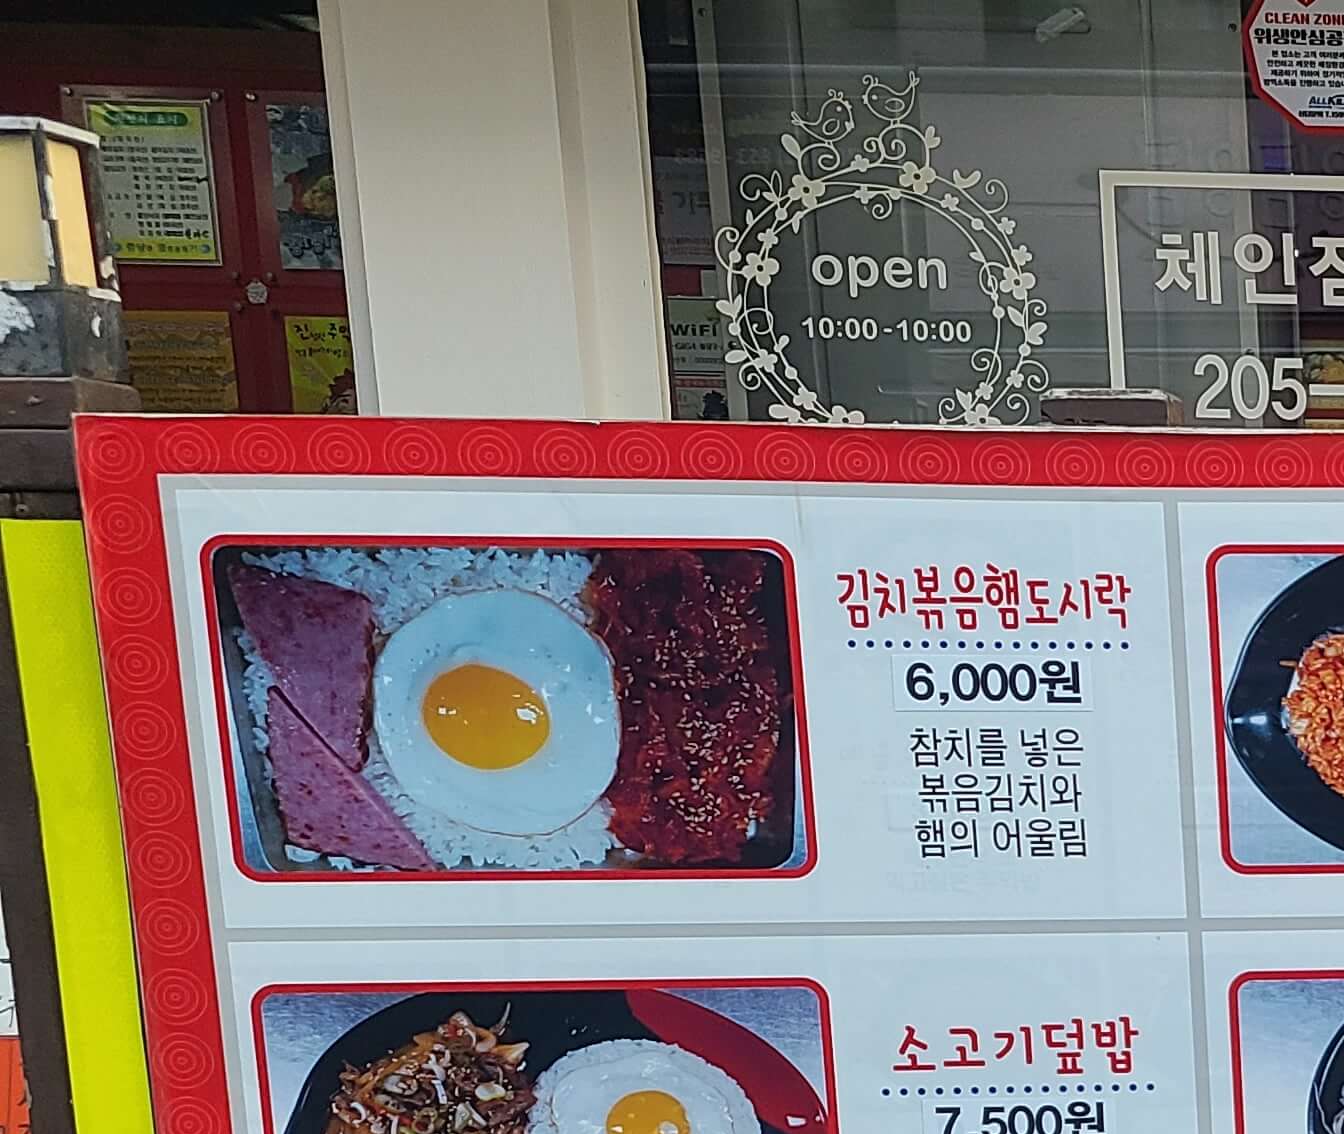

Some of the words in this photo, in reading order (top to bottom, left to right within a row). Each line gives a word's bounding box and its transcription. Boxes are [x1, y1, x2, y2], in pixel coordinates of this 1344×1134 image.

[1264, 12, 1310, 25] CLEAN
[811, 253, 948, 299] open
[836, 562, 1132, 631] 김치볶음햄도시락
[905, 659, 1083, 706] 6,000원
[909, 726, 1008, 768] 참치를
[1019, 726, 1085, 767] 넣은
[918, 773, 1083, 814] 볶음김치와
[914, 818, 980, 858] 햄의
[992, 818, 1088, 858] 어울림
[892, 1015, 1140, 1076] 소고기덮밥
